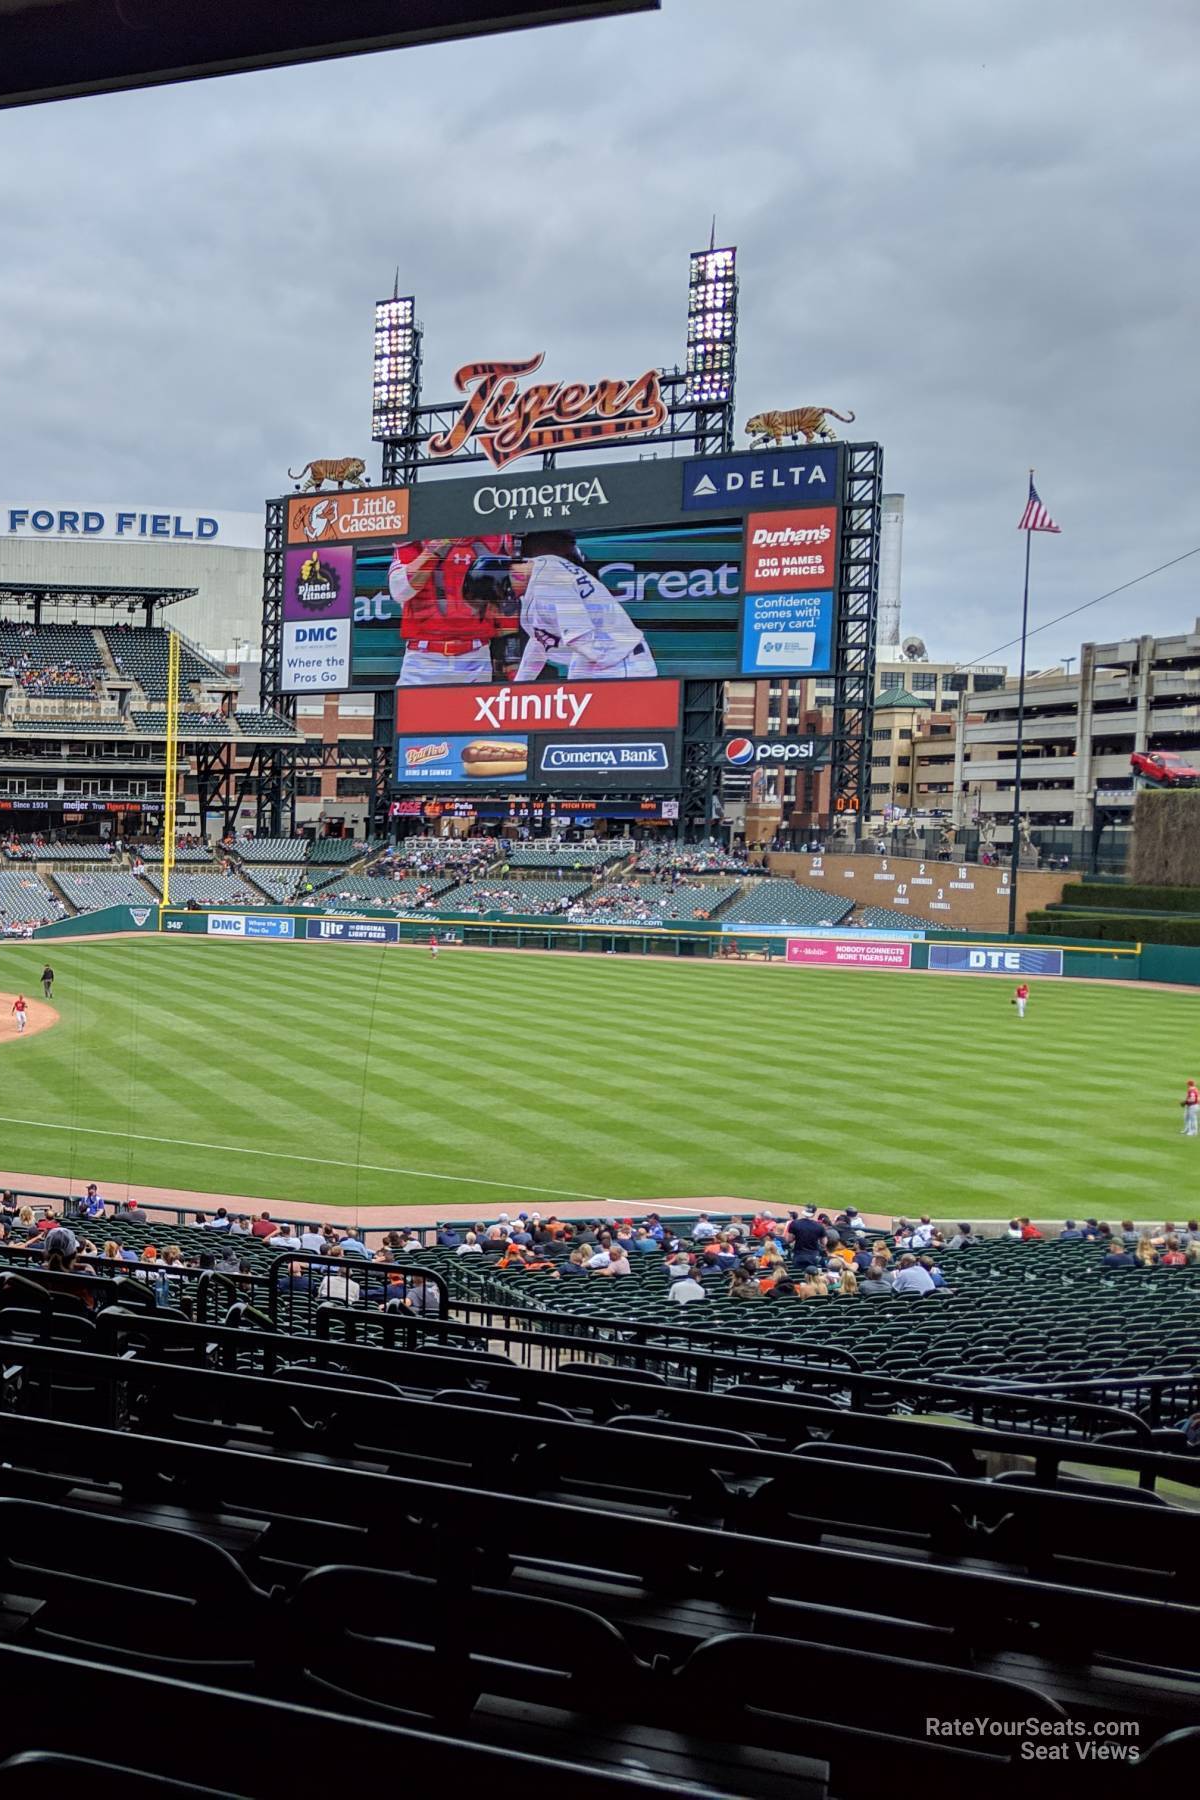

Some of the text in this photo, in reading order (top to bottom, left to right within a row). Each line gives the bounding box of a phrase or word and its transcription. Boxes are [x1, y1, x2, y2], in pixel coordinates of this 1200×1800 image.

[428, 351, 668, 471] Tigers
[726, 465, 827, 491] DELTA
[352, 496, 396, 516] Little
[509, 505, 571, 520] PARK
[8, 510, 219, 540] FORD FIELD
[338, 515, 402, 533] Caesars
[752, 524, 831, 545] Dunham's
[758, 555, 823, 567] BIG NAMES
[755, 565, 825, 578] LOW PRICES
[298, 582, 331, 595] planet
[598, 562, 739, 602] Great
[302, 590, 336, 600] fitness
[755, 596, 821, 608] Confidence
[754, 606, 820, 619] comes with
[753, 621, 786, 631] every
[295, 627, 338, 642] DMC
[287, 656, 345, 668] Where the
[293, 672, 337, 683] Pros Go
[473, 687, 593, 728] xfinity
[620, 749, 658, 762] Bank
[756, 741, 813, 761] pepsi
[64, 801, 89, 810] meijer
[882, 860, 888, 871] 5
[919, 864, 925, 875] 2
[958, 868, 966, 879] 16
[897, 884, 907, 895] 47
[937, 889, 943, 899] 3
[212, 920, 241, 930] DMC
[568, 915, 663, 927] MotorCityCasino.com
[320, 922, 344, 937] Lite
[866, 947, 904, 955] CONNECTS
[970, 951, 1020, 969] DTE
